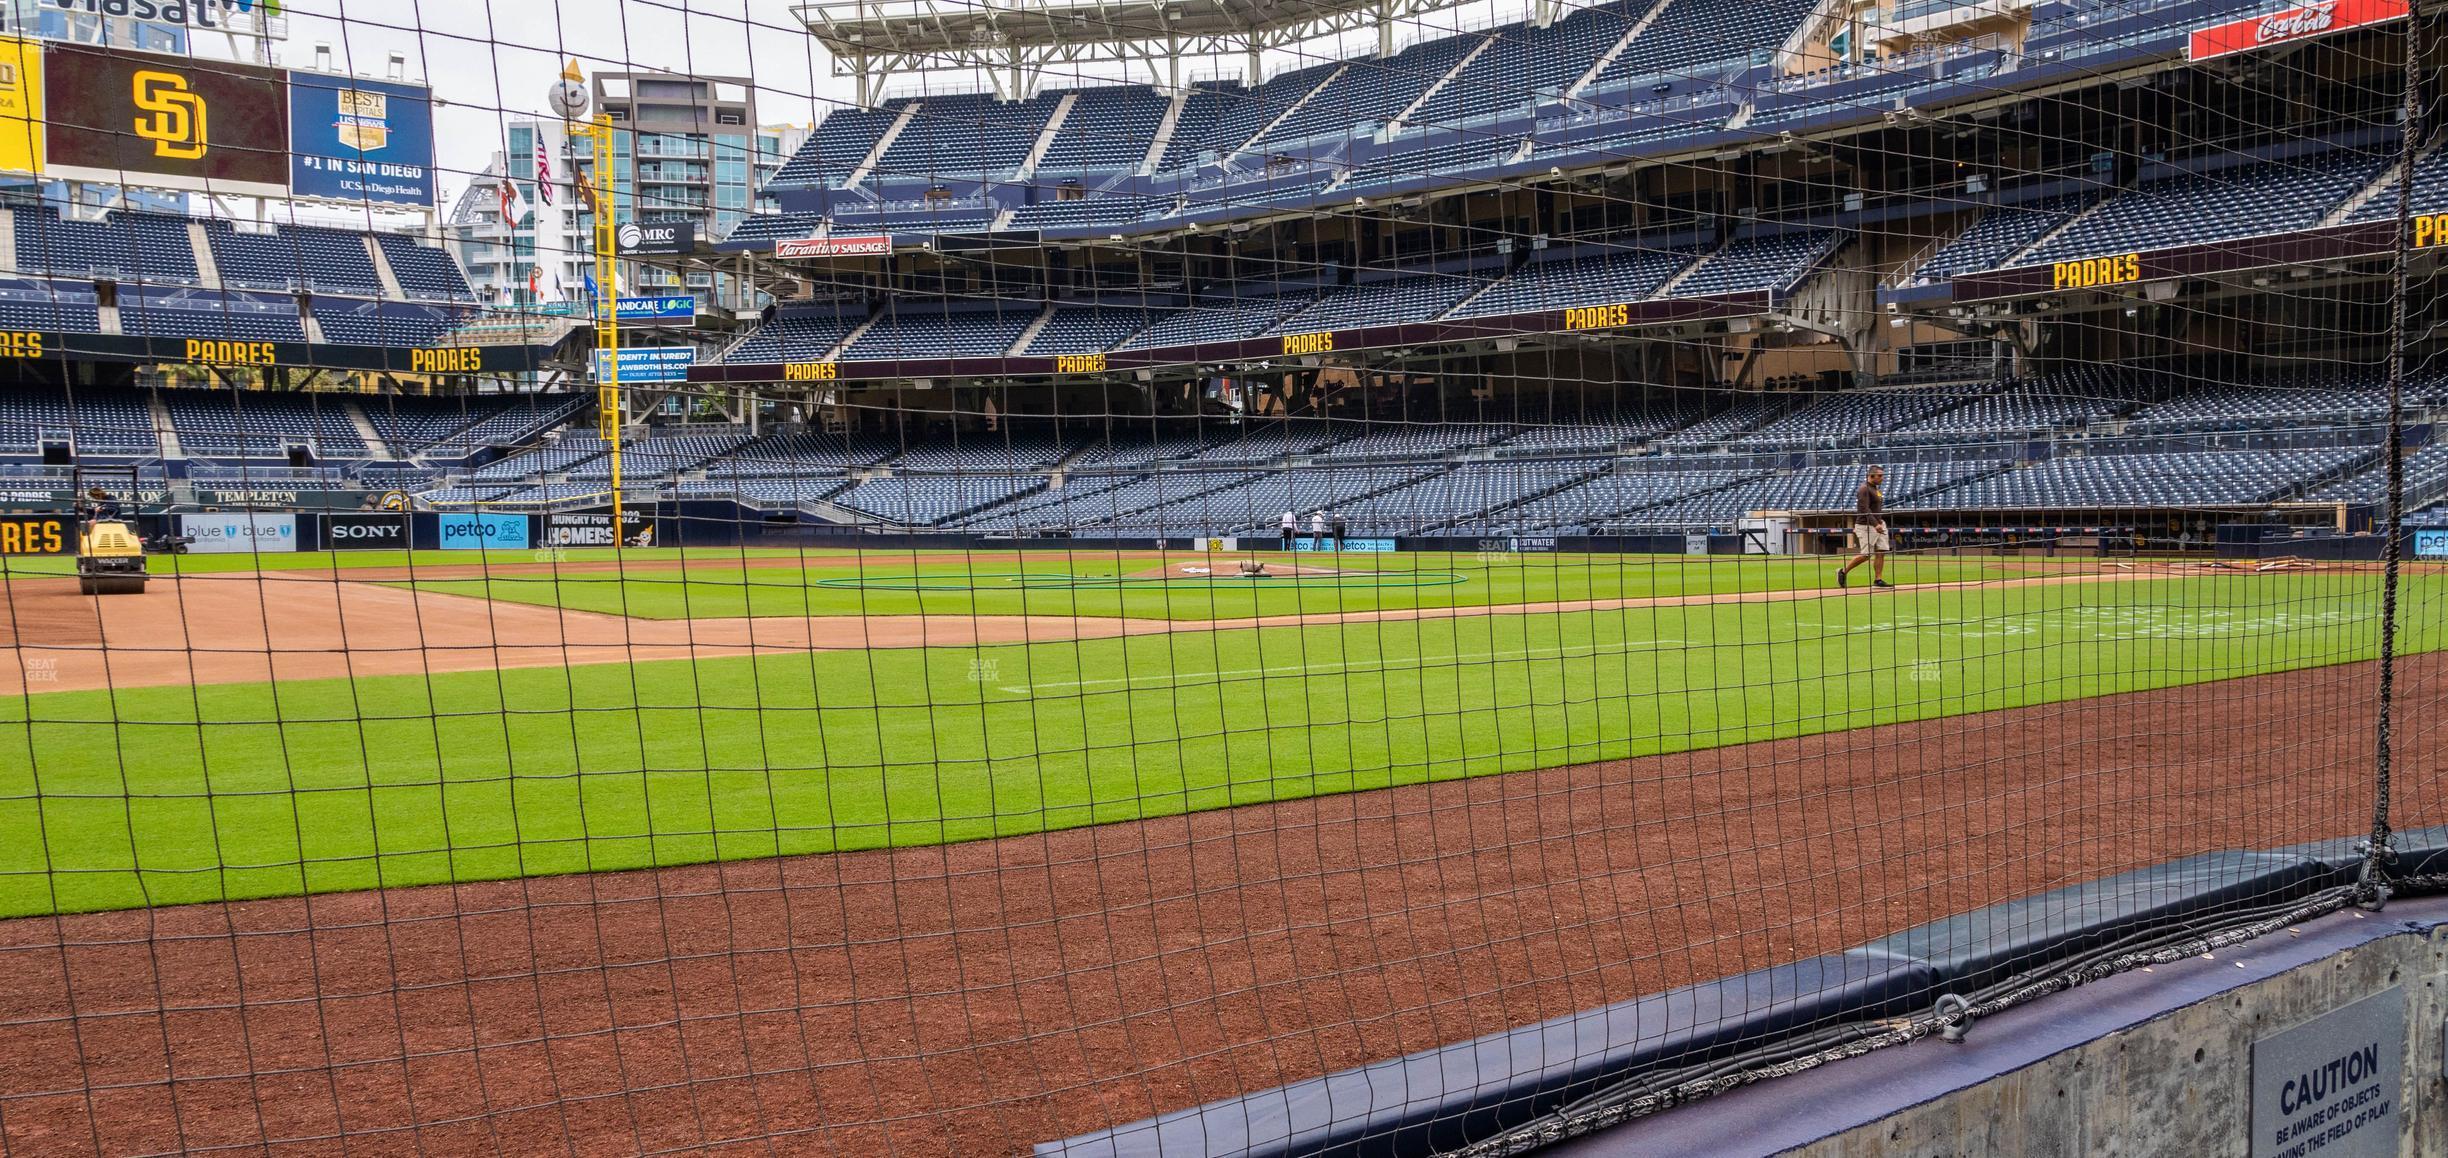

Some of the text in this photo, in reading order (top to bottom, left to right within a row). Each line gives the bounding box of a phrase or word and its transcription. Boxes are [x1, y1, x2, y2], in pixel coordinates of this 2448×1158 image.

[2255, 3, 2336, 42] Coca-Cola
[342, 90, 382, 107] BEST
[133, 70, 207, 160] SD
[304, 156, 422, 179] #1 IN SAN DIEGO
[340, 180, 422, 196] UC San Diego Health
[642, 228, 675, 240] MRC
[779, 241, 890, 256] Tarantino SAUSAGES
[2054, 253, 2140, 290] PADRES
[616, 301, 659, 312] ANDCARE
[1566, 303, 1628, 330] PADRES
[1284, 332, 1334, 354] PADRES
[186, 339, 275, 366] PADRES
[412, 348, 481, 373] PADRES
[602, 353, 648, 361] ACIDENT?
[785, 363, 836, 381] PADRES
[1058, 354, 1106, 373] PADRES
[11, 491, 52, 501] PADRES
[215, 491, 297, 503] TEMPLETON
[552, 515, 589, 525] HUNGRY
[591, 515, 610, 525] FOR
[187, 525, 276, 537] blue blue
[332, 525, 401, 538] SONY
[445, 521, 496, 541] petco
[548, 527, 614, 545] HOMERS
[2281, 1043, 2377, 1115] CAUTION
[2276, 1083, 2380, 1145] BE AWARE OF OBJECTS
[2308, 1132, 2326, 1152] THE
[2327, 1119, 2353, 1143] FIELD
[2354, 1112, 2367, 1129] OF
[2368, 1100, 2390, 1122] PLAY
